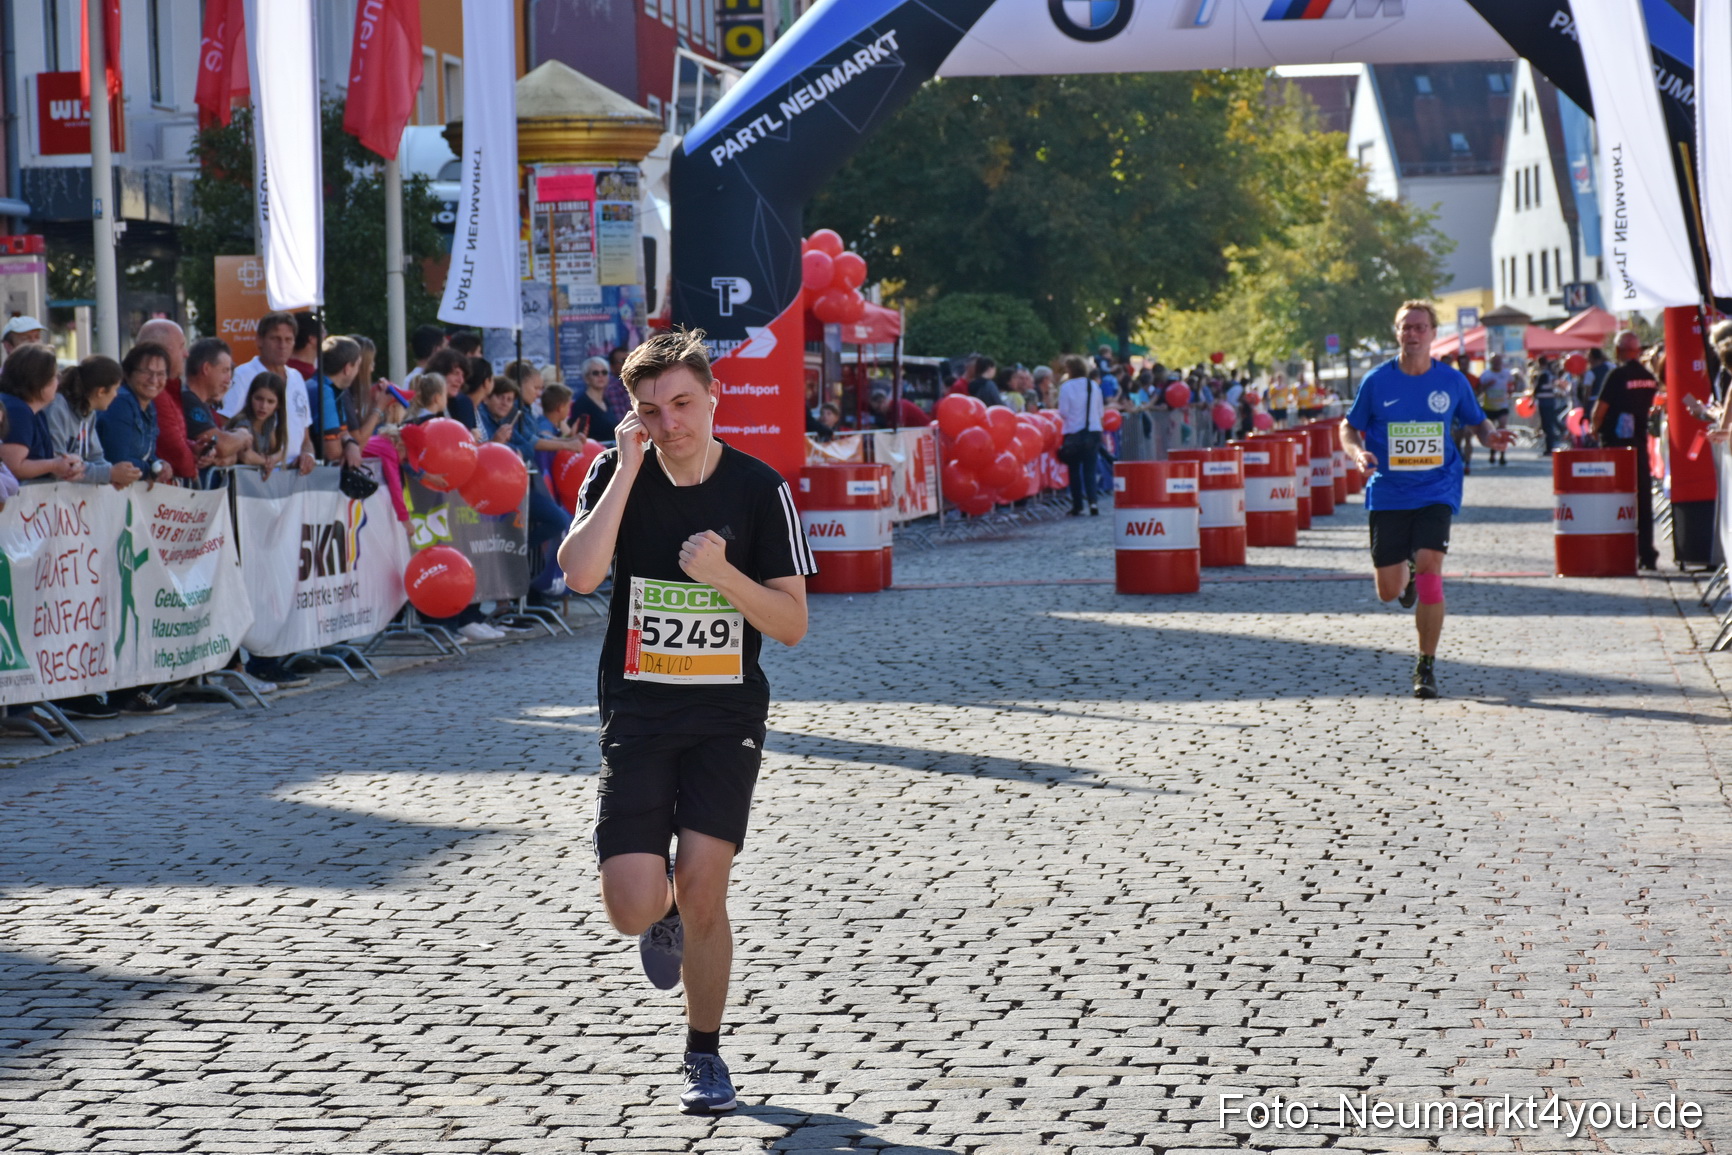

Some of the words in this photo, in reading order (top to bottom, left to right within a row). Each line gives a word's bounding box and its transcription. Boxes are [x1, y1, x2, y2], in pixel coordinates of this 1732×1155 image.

[710, 113, 784, 168] PARTL
[778, 29, 900, 121] NEUMARKT
[721, 383, 780, 397] Laufsport
[712, 424, 781, 435] .bmw-partl.de
[1392, 424, 1439, 436] BOCK
[1395, 439, 1437, 454] 5075
[156, 524, 171, 541] 91
[808, 519, 846, 537] AVIA
[1125, 517, 1166, 536] AVIA
[643, 586, 730, 609] BOCK
[641, 615, 730, 649] 5249
[643, 653, 694, 675] DAVID
